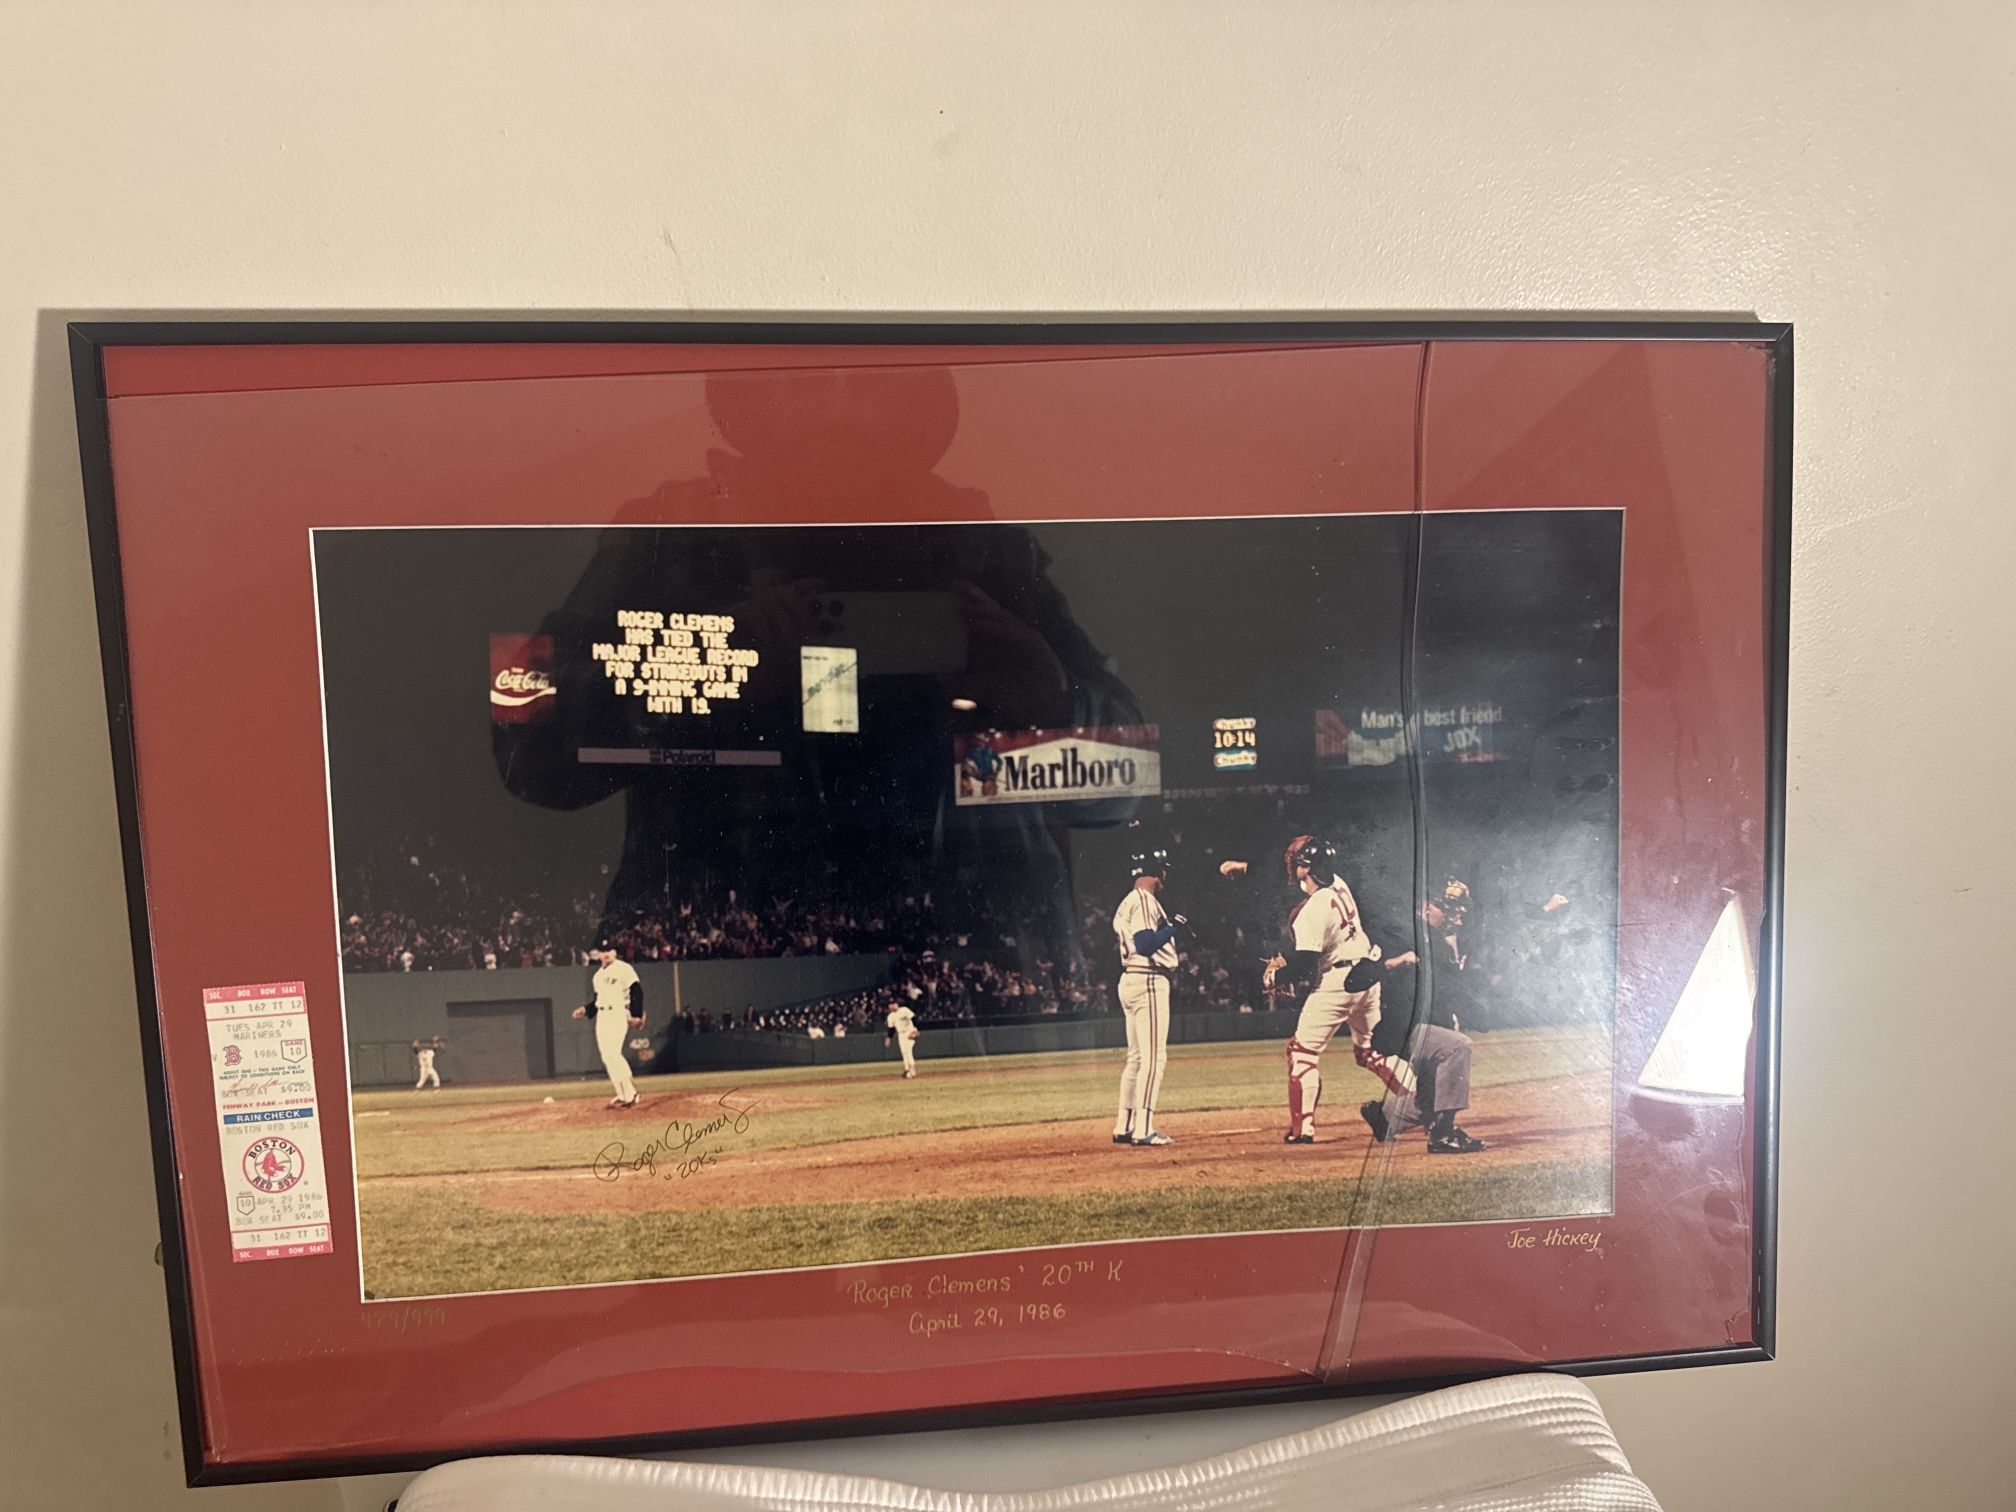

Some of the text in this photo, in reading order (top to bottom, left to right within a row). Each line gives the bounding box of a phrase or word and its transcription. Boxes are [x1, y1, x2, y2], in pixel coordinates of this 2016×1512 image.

[617, 610, 735, 632] ROGER CLEMENS
[625, 628, 728, 649] HAS TIED THE
[592, 643, 759, 667] MAJOR LEAGUE RECORD
[605, 660, 748, 682] FOR STRIKEOUTS IN
[702, 681, 740, 699] GAME
[647, 695, 683, 714] WITH
[1424, 707, 1456, 726] best
[1003, 746, 1137, 791] Marlboro
[223, 1005, 236, 1014] 31
[226, 1019, 293, 1033] TUES APR 29
[232, 1029, 282, 1041] MARINERS
[253, 1048, 278, 1059] 1986
[289, 1046, 302, 1056] 10
[236, 1110, 301, 1122] RAIN CHECK
[225, 1125, 262, 1135] BOSTON
[248, 1139, 296, 1159] BOSTON
[252, 1172, 297, 1191] RED SOX
[273, 1232, 291, 1241] 162
[315, 1228, 326, 1237] 12
[1507, 1226, 1602, 1253] Joe Hickey
[288, 1247, 304, 1255] ROW
[309, 1244, 324, 1253] SEAT
[1107, 1259, 1124, 1282] K
[908, 1302, 1067, 1338] April 29, 1986
